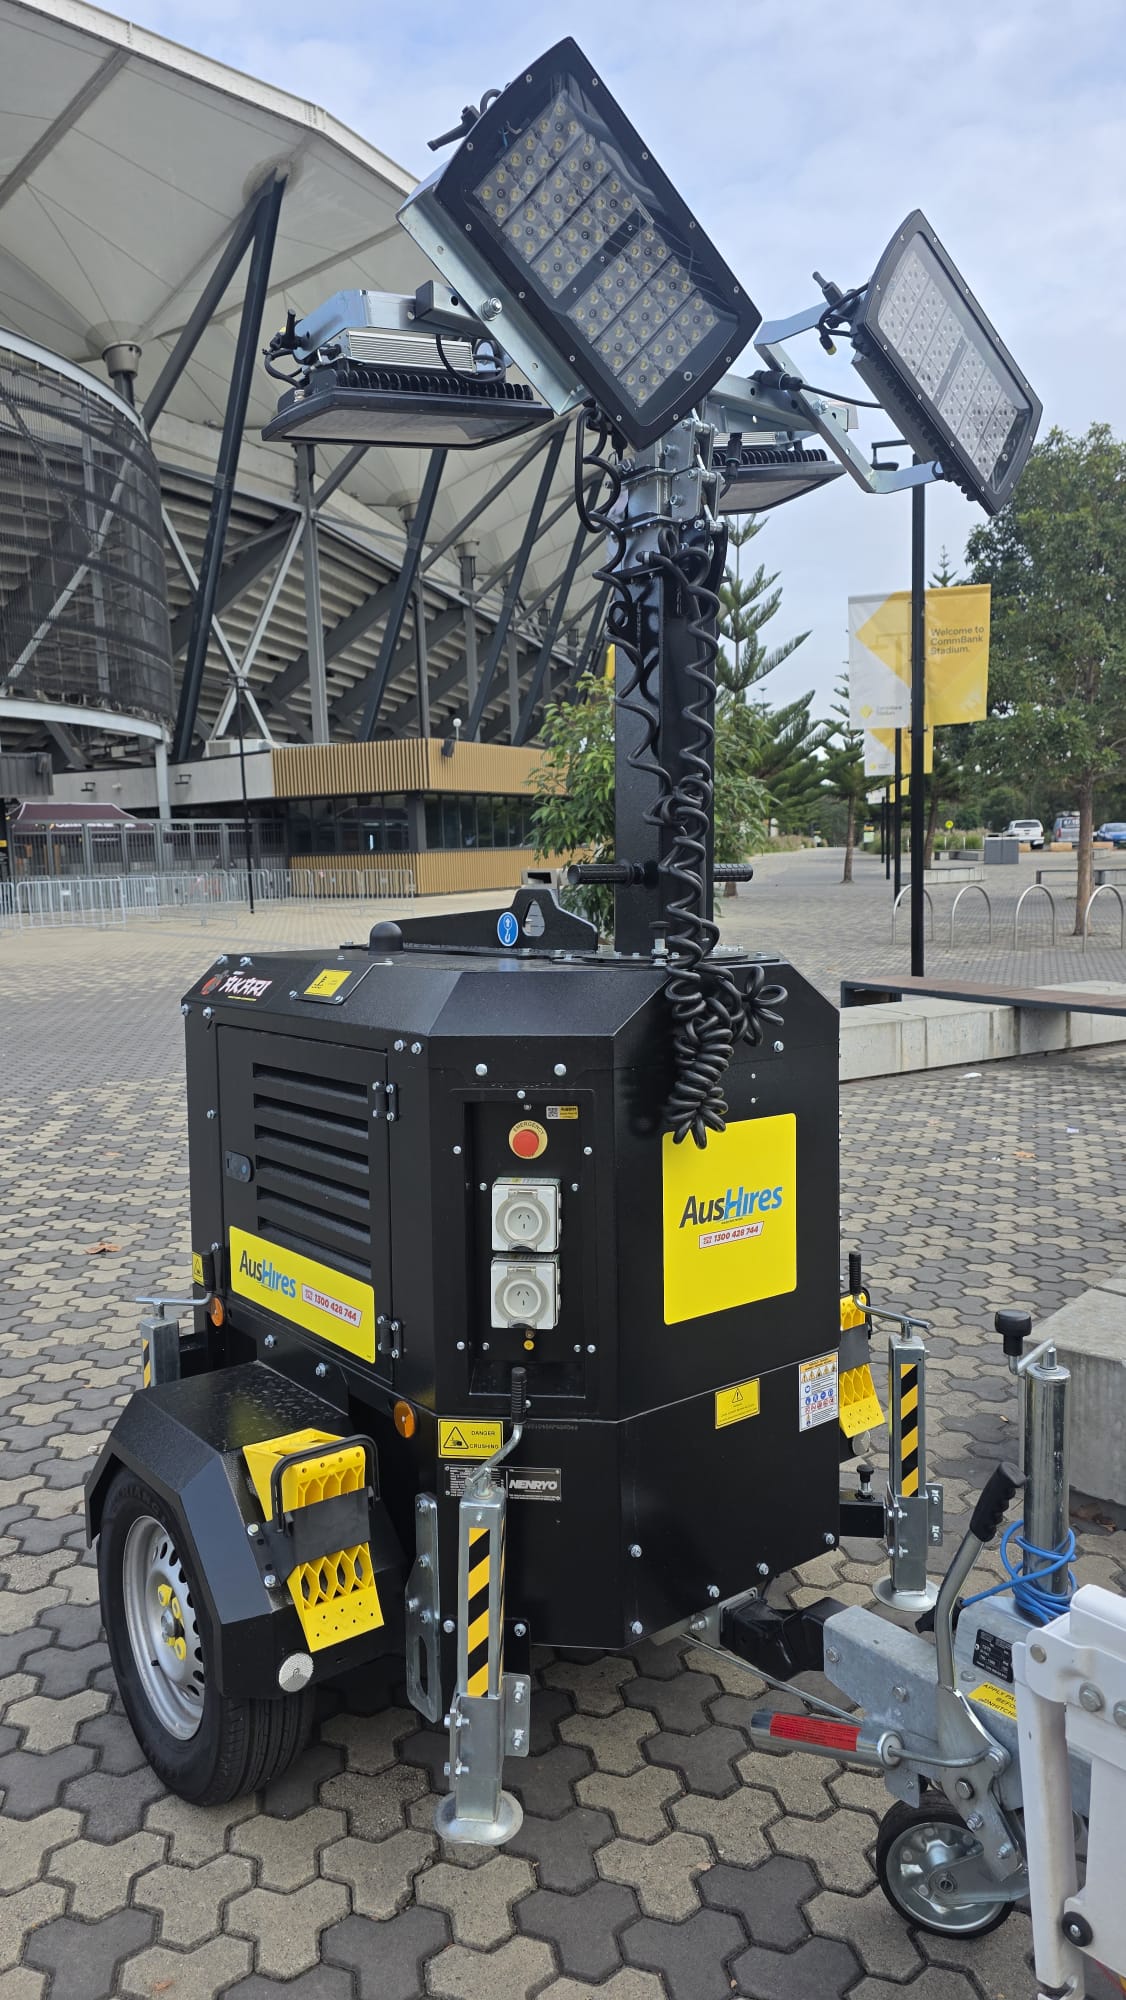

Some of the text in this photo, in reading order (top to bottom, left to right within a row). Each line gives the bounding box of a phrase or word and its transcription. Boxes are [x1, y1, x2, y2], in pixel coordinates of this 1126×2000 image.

[931, 627, 973, 636] Welcome
[930, 635, 983, 646] CommBank
[513, 1121, 544, 1135] EMERGENCY
[679, 1186, 783, 1229] AusHires
[714, 1225, 759, 1242] 1300 428 744
[240, 1250, 297, 1298] AusHires
[314, 1294, 357, 1321] 1300 428 744
[508, 1479, 558, 1491] NENRYO
[983, 1683, 1006, 1696] APPLY
[995, 1696, 1017, 1710] BEFO
